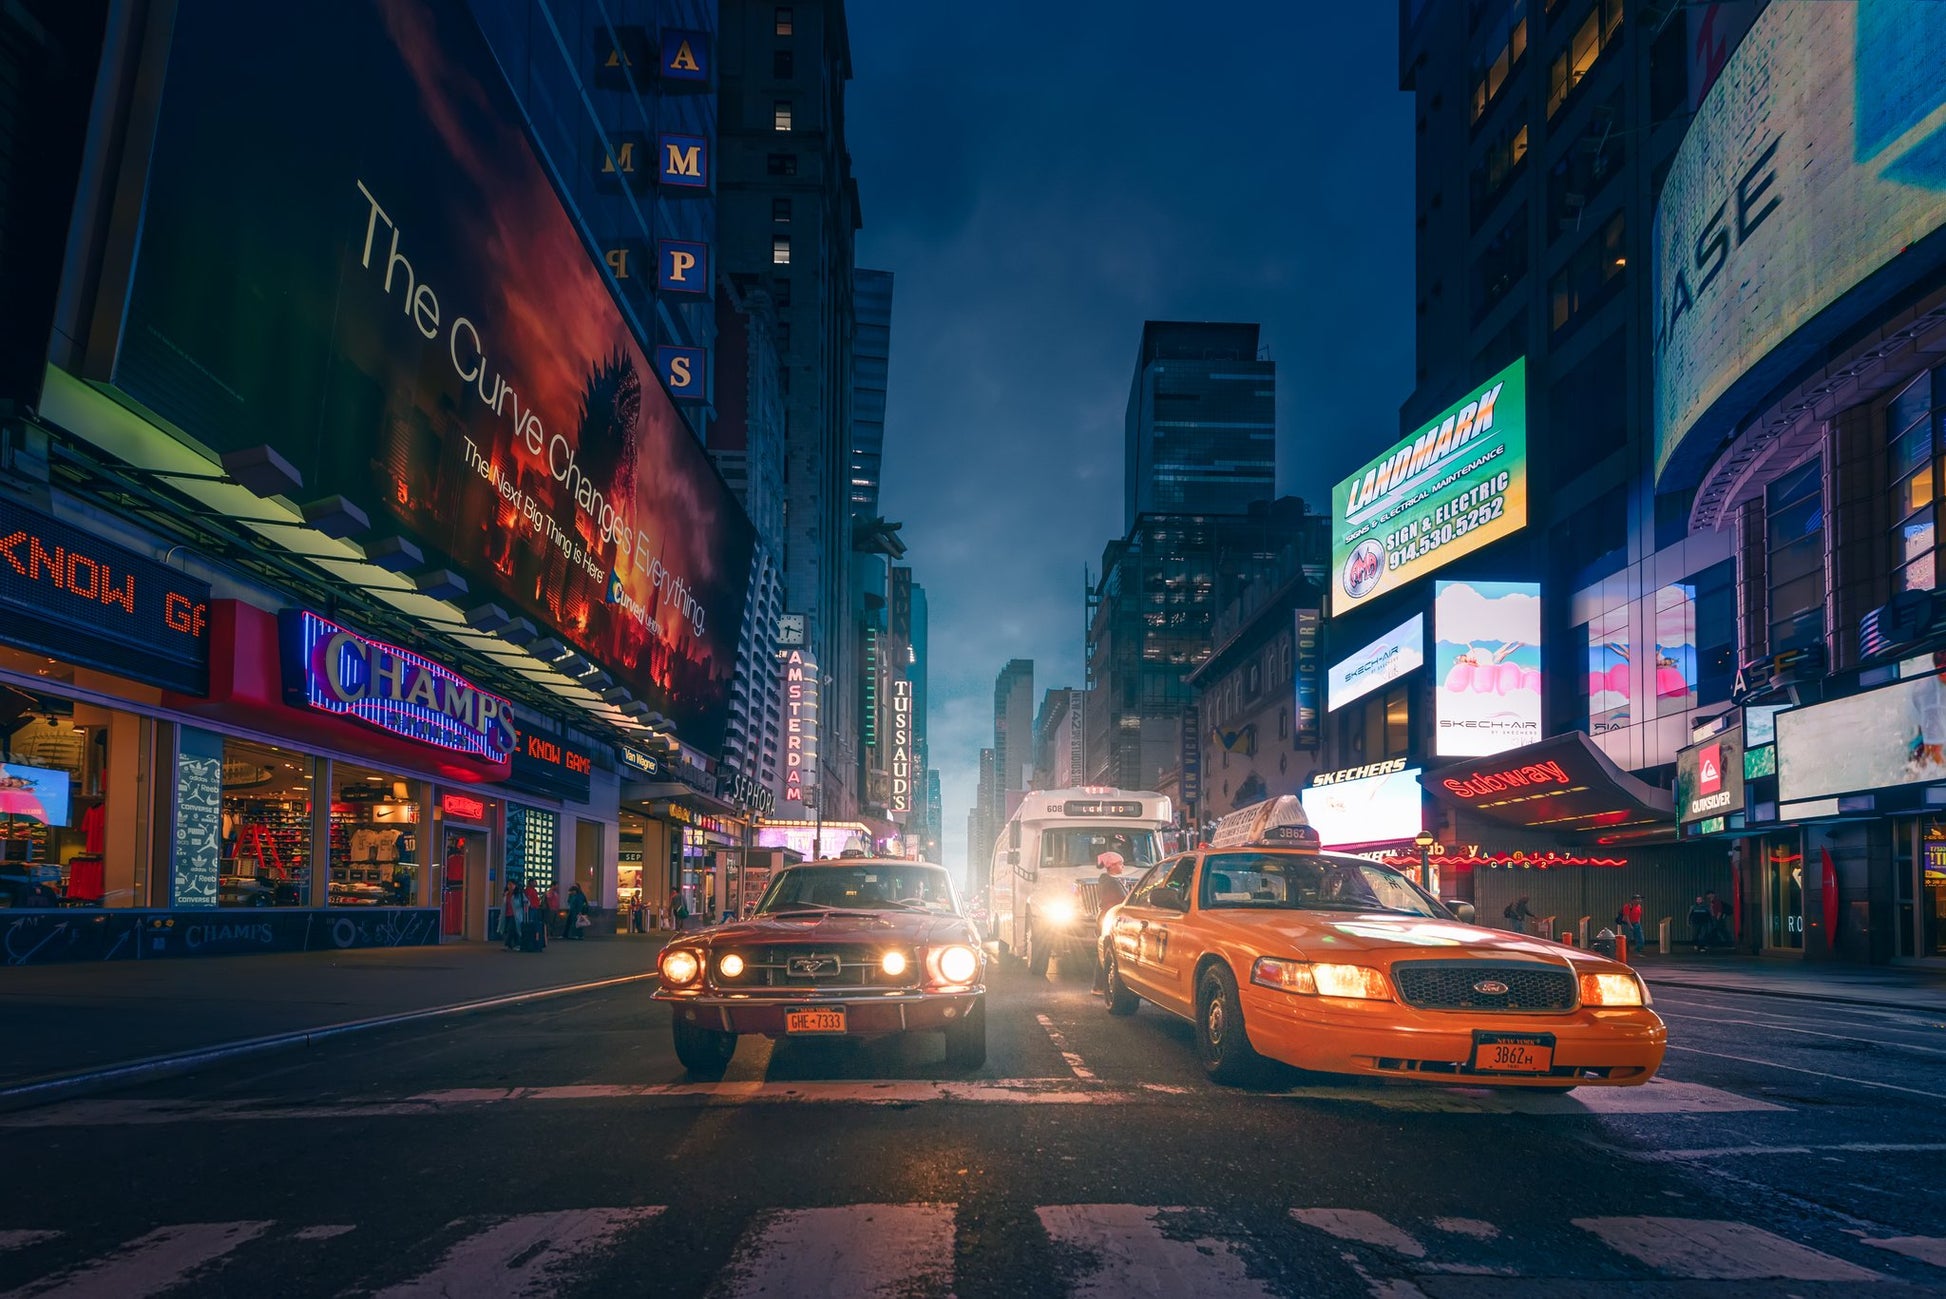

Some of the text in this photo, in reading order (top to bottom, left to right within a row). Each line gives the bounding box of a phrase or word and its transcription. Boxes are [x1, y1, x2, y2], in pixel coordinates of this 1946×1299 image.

[357, 178, 706, 637] The Curve Changes Everything.
[1346, 380, 1504, 519] LANDMARK
[463, 435, 604, 584] The Next Big Thing is Here
[1345, 444, 1505, 544] SIGNS & ELECTRICAL MAINTENANCE
[1386, 471, 1508, 551] SIGN & ELECTRIC
[1388, 496, 1505, 572] 914.530.5252
[612, 582, 646, 626] Curved
[1300, 614, 1316, 694] VICTORY
[1344, 645, 1399, 683] SKECH-AIR
[325, 631, 517, 753] CHAMPS
[787, 651, 803, 800] AMSTERDAM
[1439, 719, 1537, 730] SKECH-AIR
[528, 735, 561, 765] KNOW
[624, 747, 656, 771] Van Wagner
[1312, 757, 1407, 788] SKECHERS
[1443, 760, 1570, 798] Subway
[733, 774, 776, 816] SEPHORA
[1047, 805, 1063, 813] 608
[1692, 791, 1731, 813] QUIKSILVER
[1280, 828, 1305, 838] 3B62
[1482, 984, 1500, 992] Ford
[1494, 1046, 1533, 1064] 3B62H
